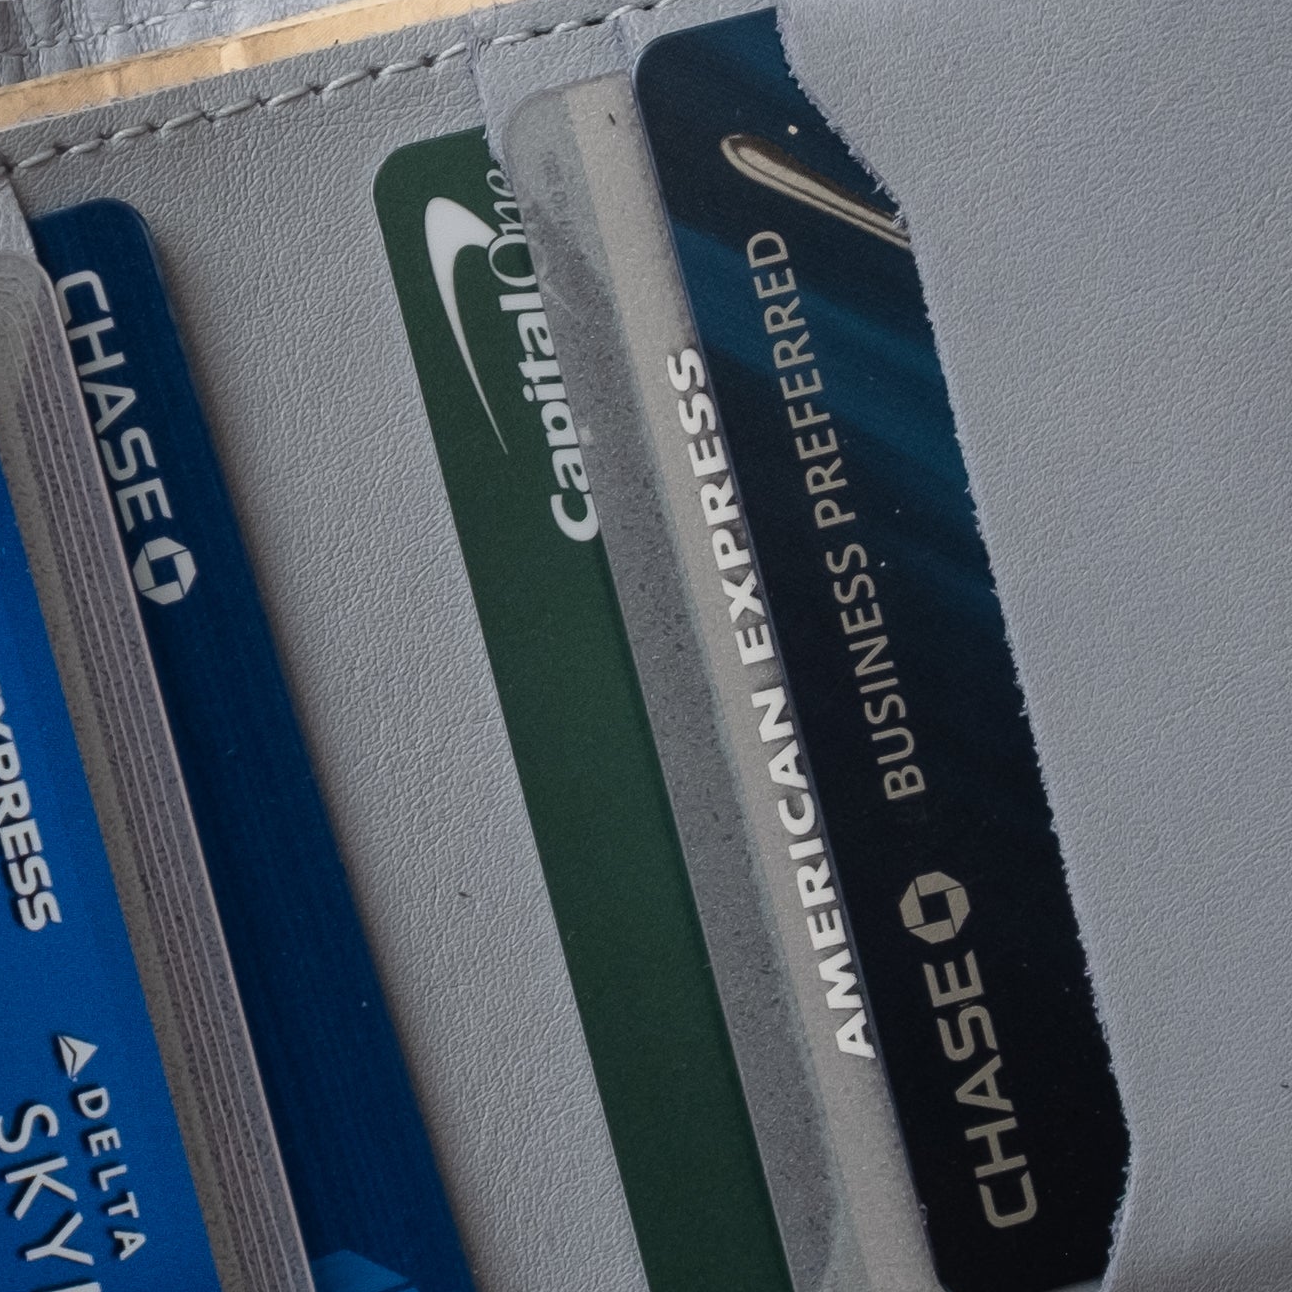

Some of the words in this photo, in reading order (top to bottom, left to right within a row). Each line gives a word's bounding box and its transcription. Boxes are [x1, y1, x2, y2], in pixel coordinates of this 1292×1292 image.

[55, 269, 172, 531] CHASE
[666, 347, 776, 667] EXPRESS
[746, 230, 856, 530] PREFERRED
[824, 543, 926, 801] BUSINESS
[750, 685, 877, 1059] AMERICAN
[76, 1087, 146, 1261] DELTA
[922, 950, 1038, 1229] CHASE
